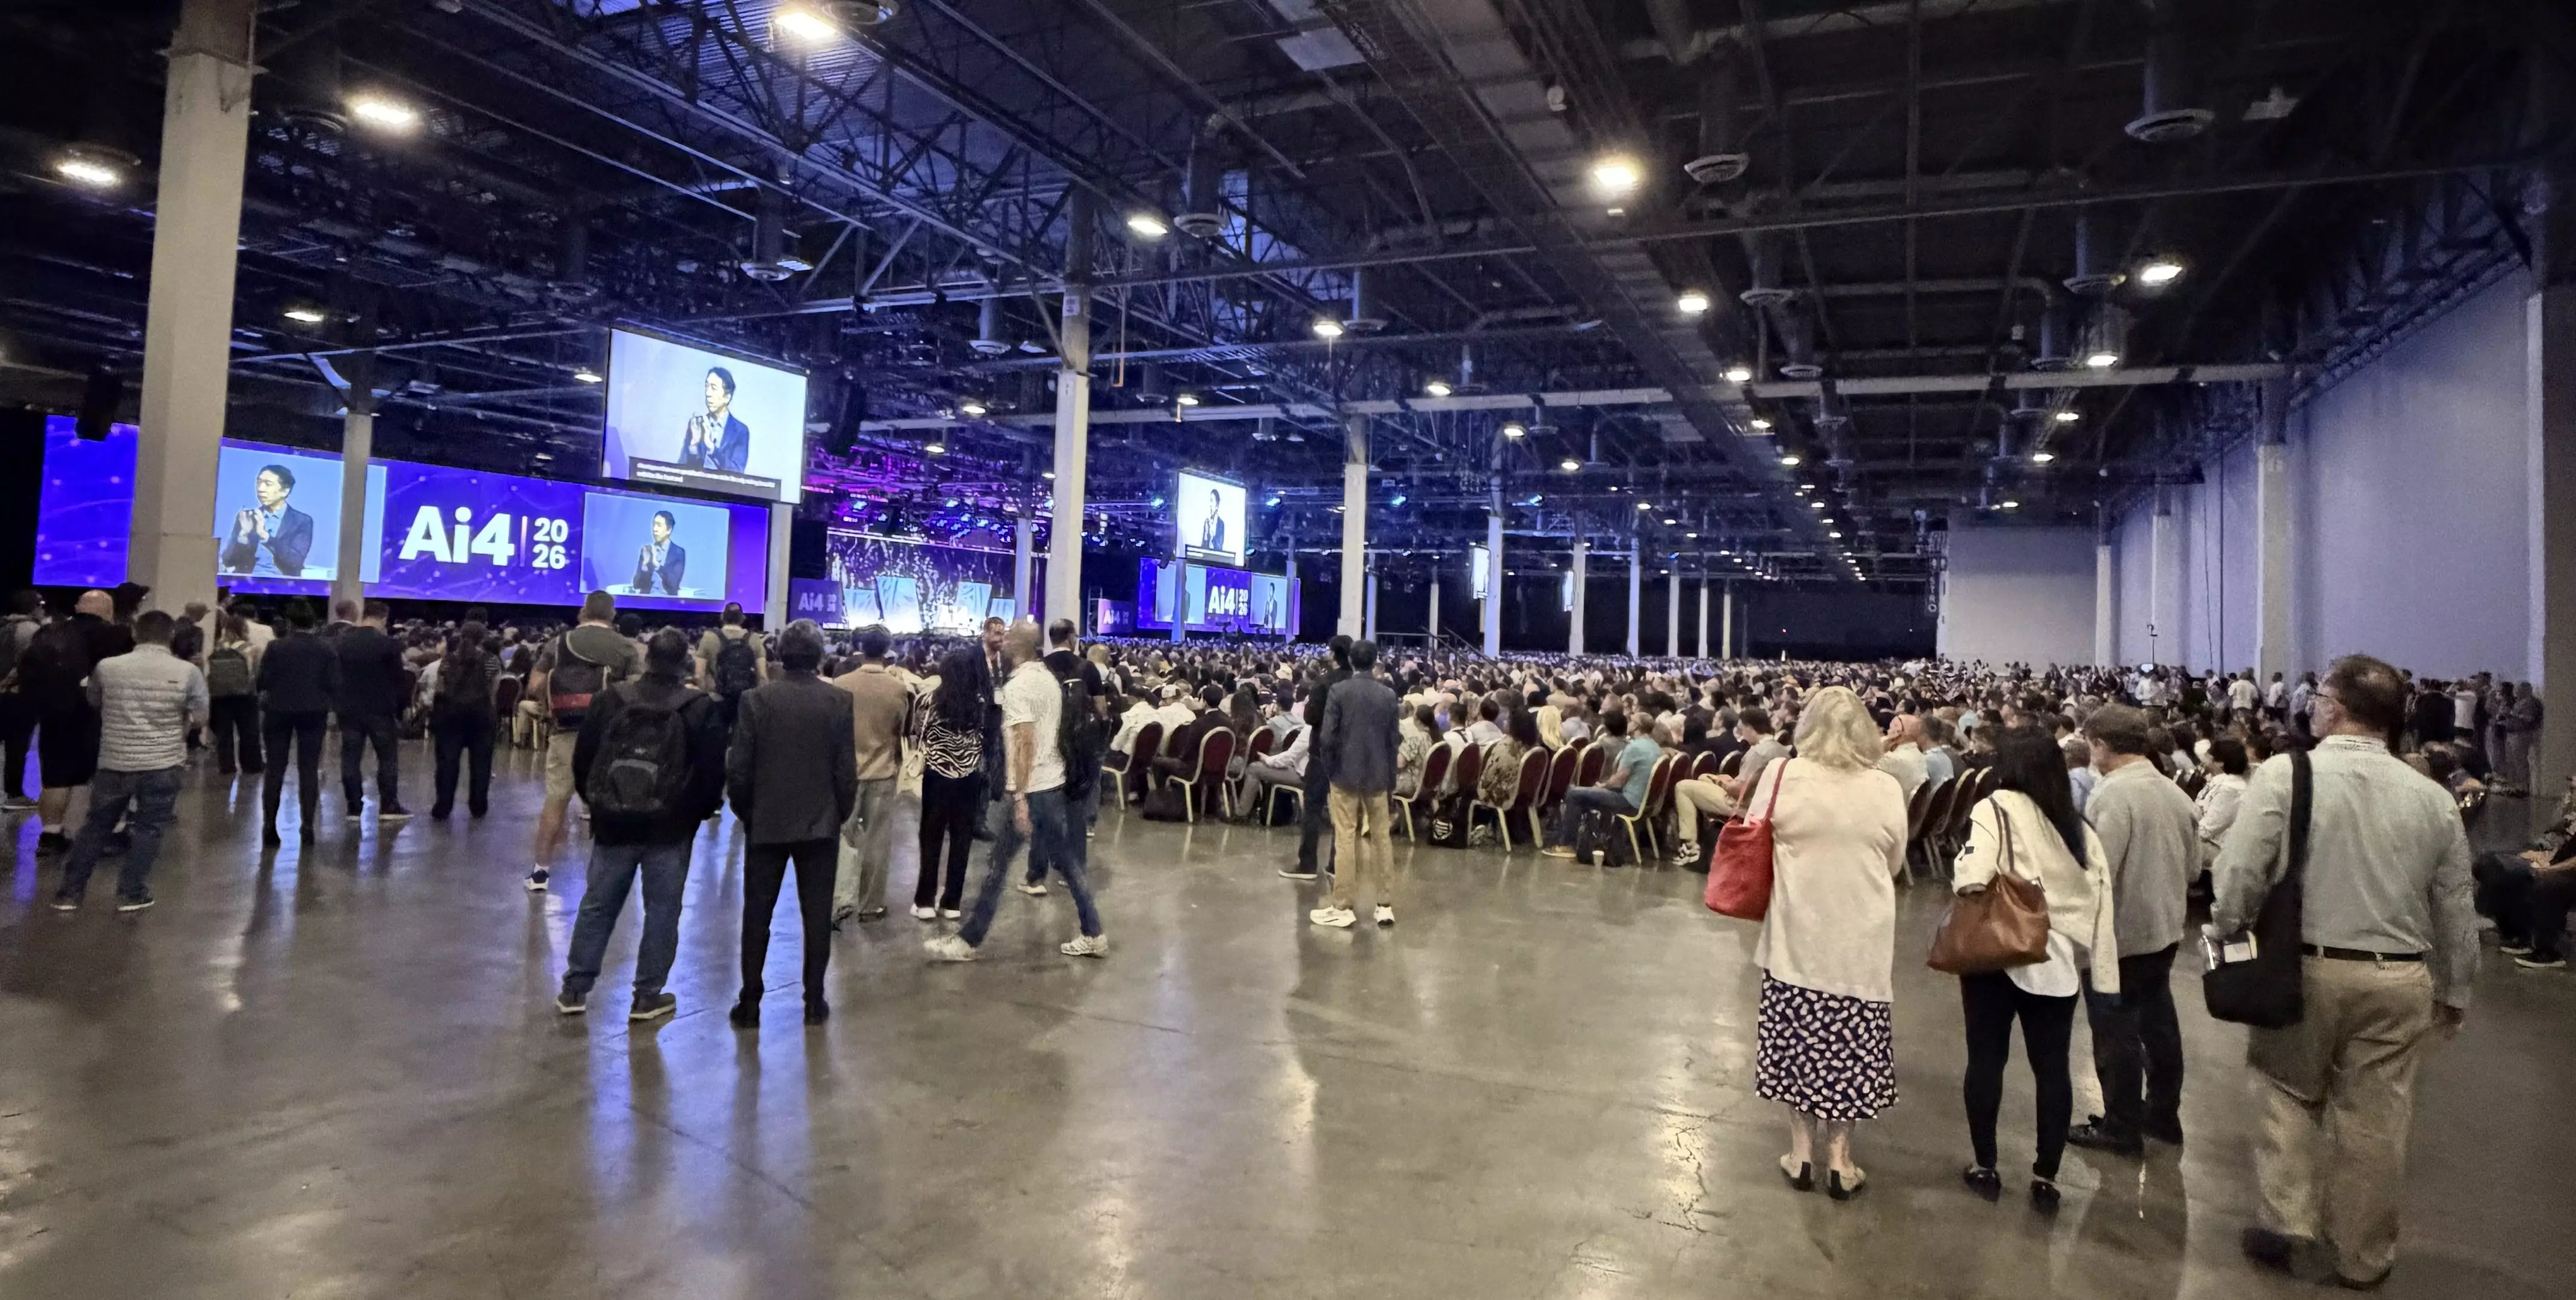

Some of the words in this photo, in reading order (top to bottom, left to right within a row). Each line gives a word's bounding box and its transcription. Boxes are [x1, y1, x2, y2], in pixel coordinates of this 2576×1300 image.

[399, 506, 515, 566] Ai4
[533, 517, 568, 543] 20
[532, 544, 566, 569] 26
[798, 592, 824, 612] Ai4
[1208, 585, 1236, 616] Ai4
